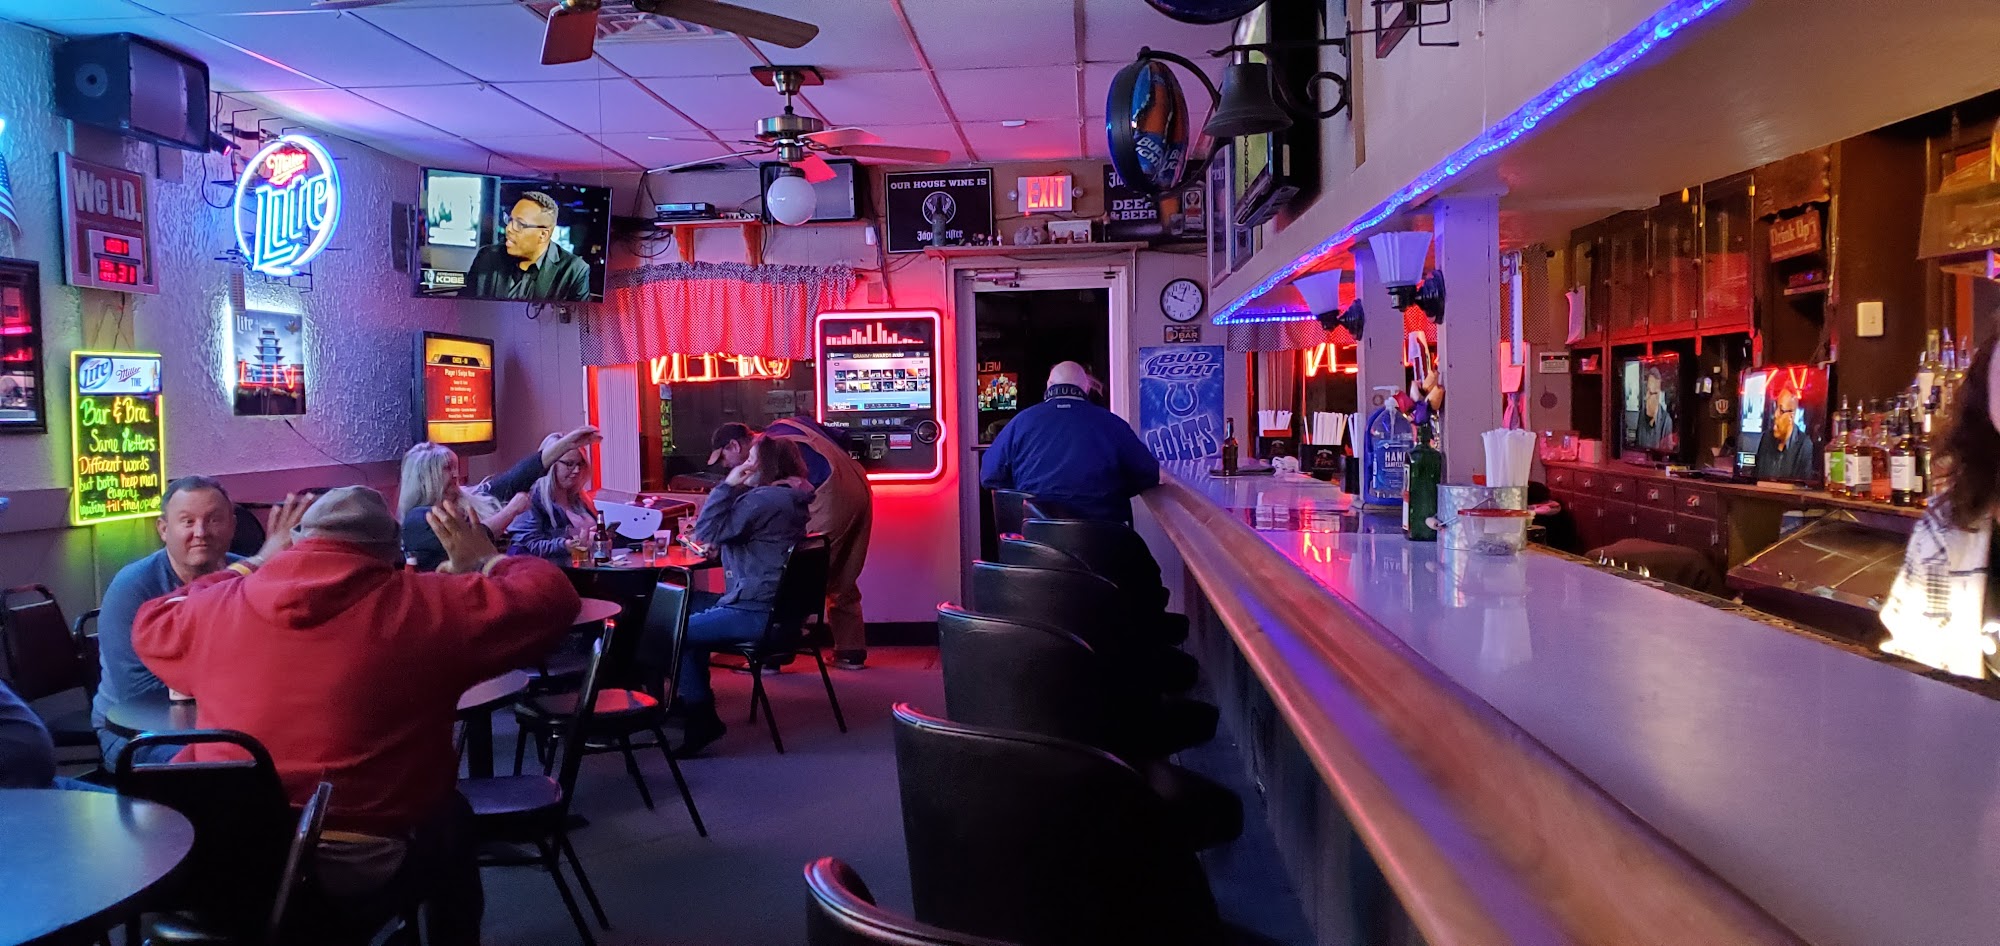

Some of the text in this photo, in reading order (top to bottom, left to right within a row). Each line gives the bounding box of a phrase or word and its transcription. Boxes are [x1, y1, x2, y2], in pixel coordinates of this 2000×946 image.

[72, 168, 109, 215] We
[890, 178, 987, 190] OUR HOUSE WINE IS
[1027, 177, 1065, 208] EXIT
[253, 174, 330, 271] Lite
[1121, 209, 1158, 220] BEER
[436, 276, 464, 285] KOBE
[236, 315, 254, 334] Lite
[1159, 352, 1211, 363] BUD
[83, 361, 109, 389] Lite
[116, 367, 142, 383] Miller
[1147, 364, 1219, 376] LIGHT
[80, 398, 111, 426] Bar
[122, 398, 151, 423] Bra
[1146, 415, 1217, 460] COLTS
